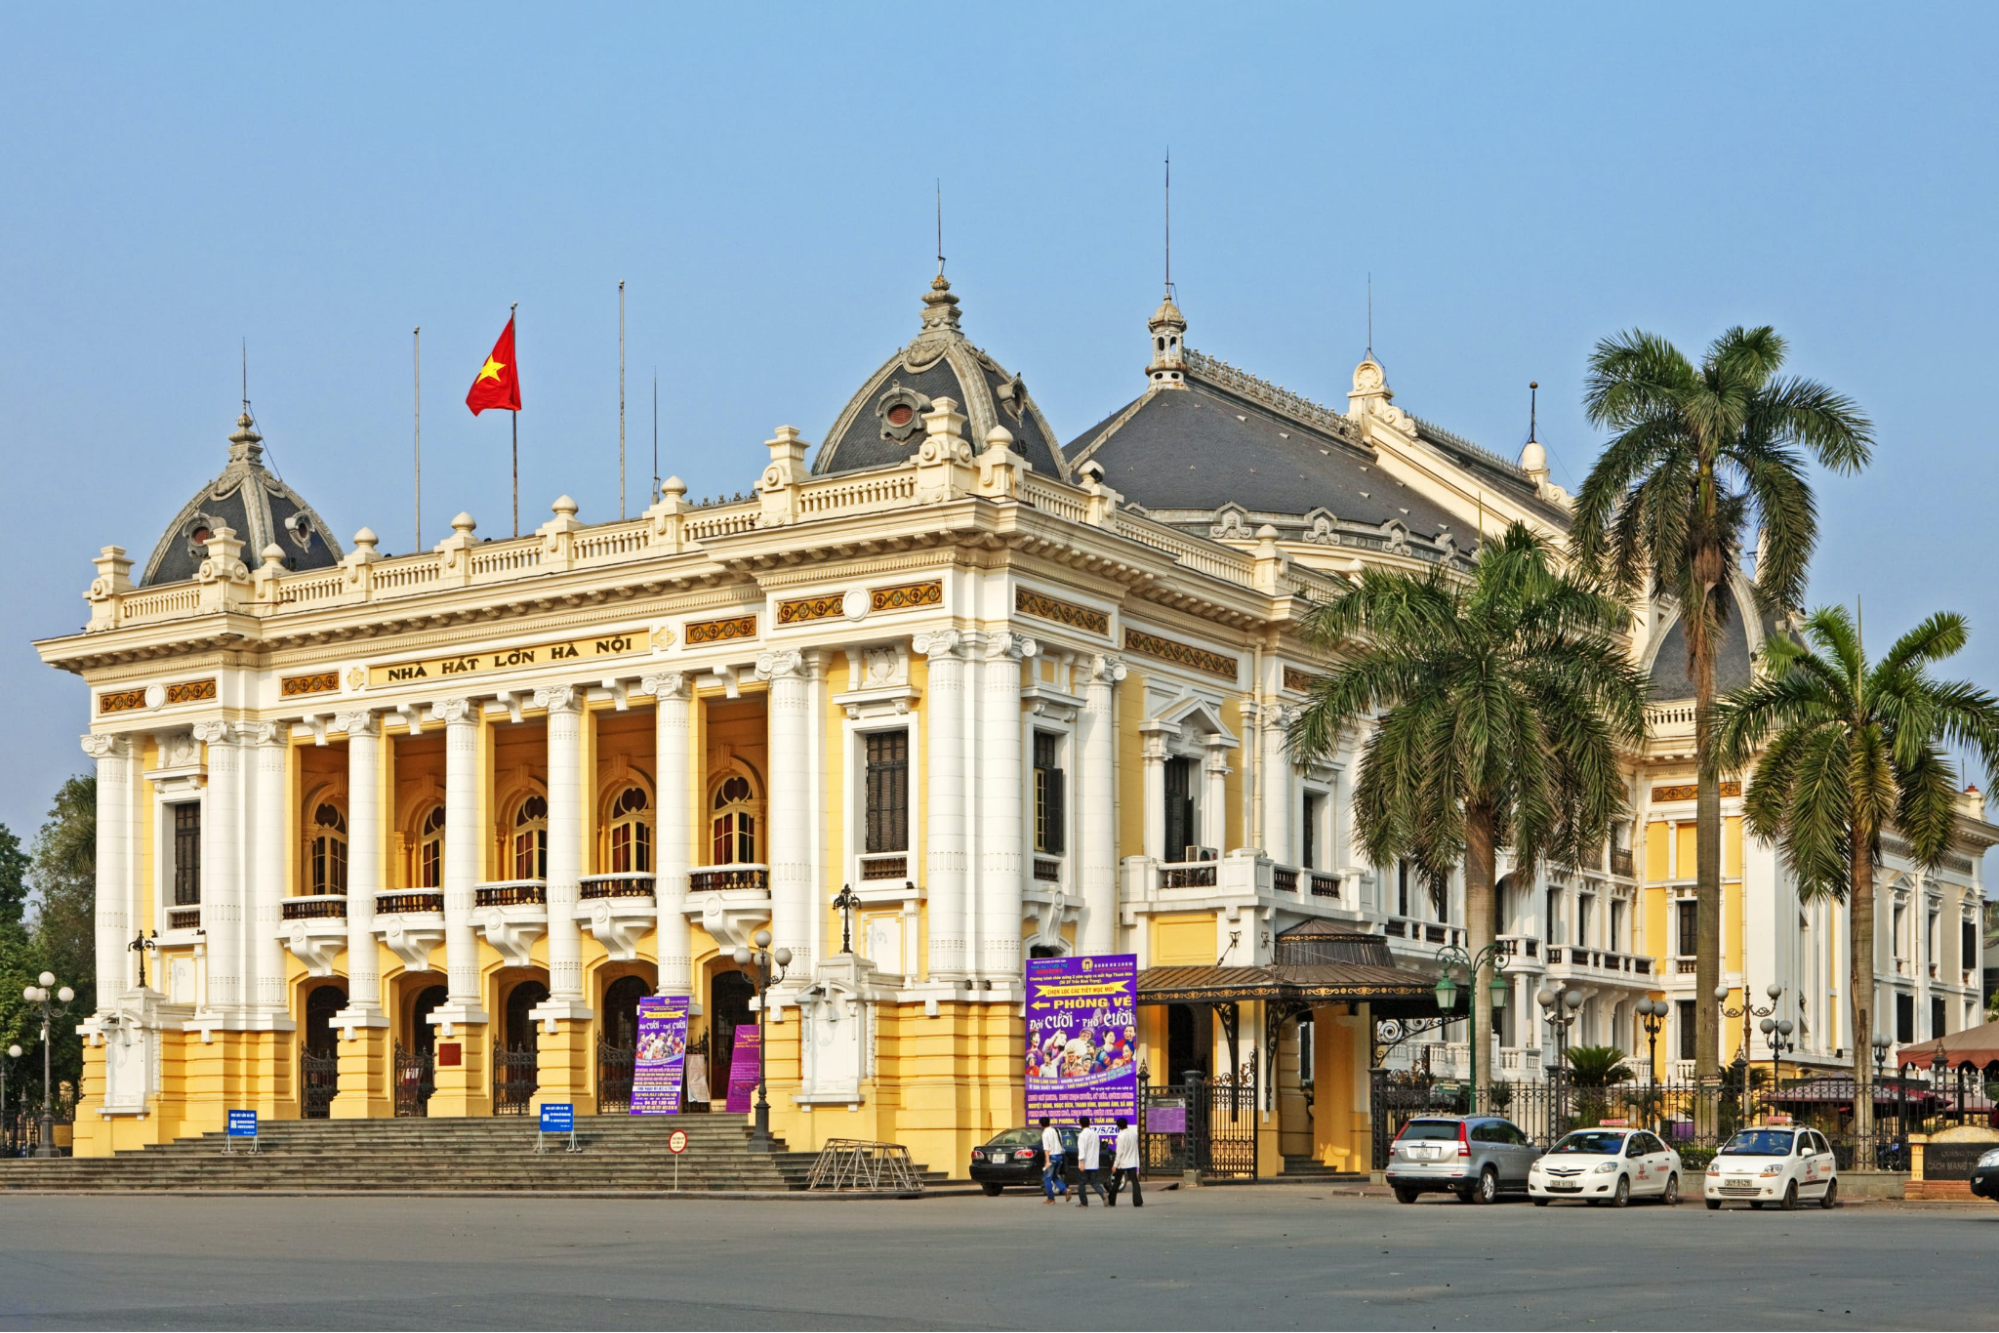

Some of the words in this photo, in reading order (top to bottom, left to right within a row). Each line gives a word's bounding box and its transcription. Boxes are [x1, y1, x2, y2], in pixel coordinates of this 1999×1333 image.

[388, 662, 427, 681] NHÀ
[442, 657, 479, 674] HÁT
[551, 640, 579, 659] HÀ
[596, 635, 631, 653] NỘI
[1054, 997, 1108, 1009] PHÒNG
